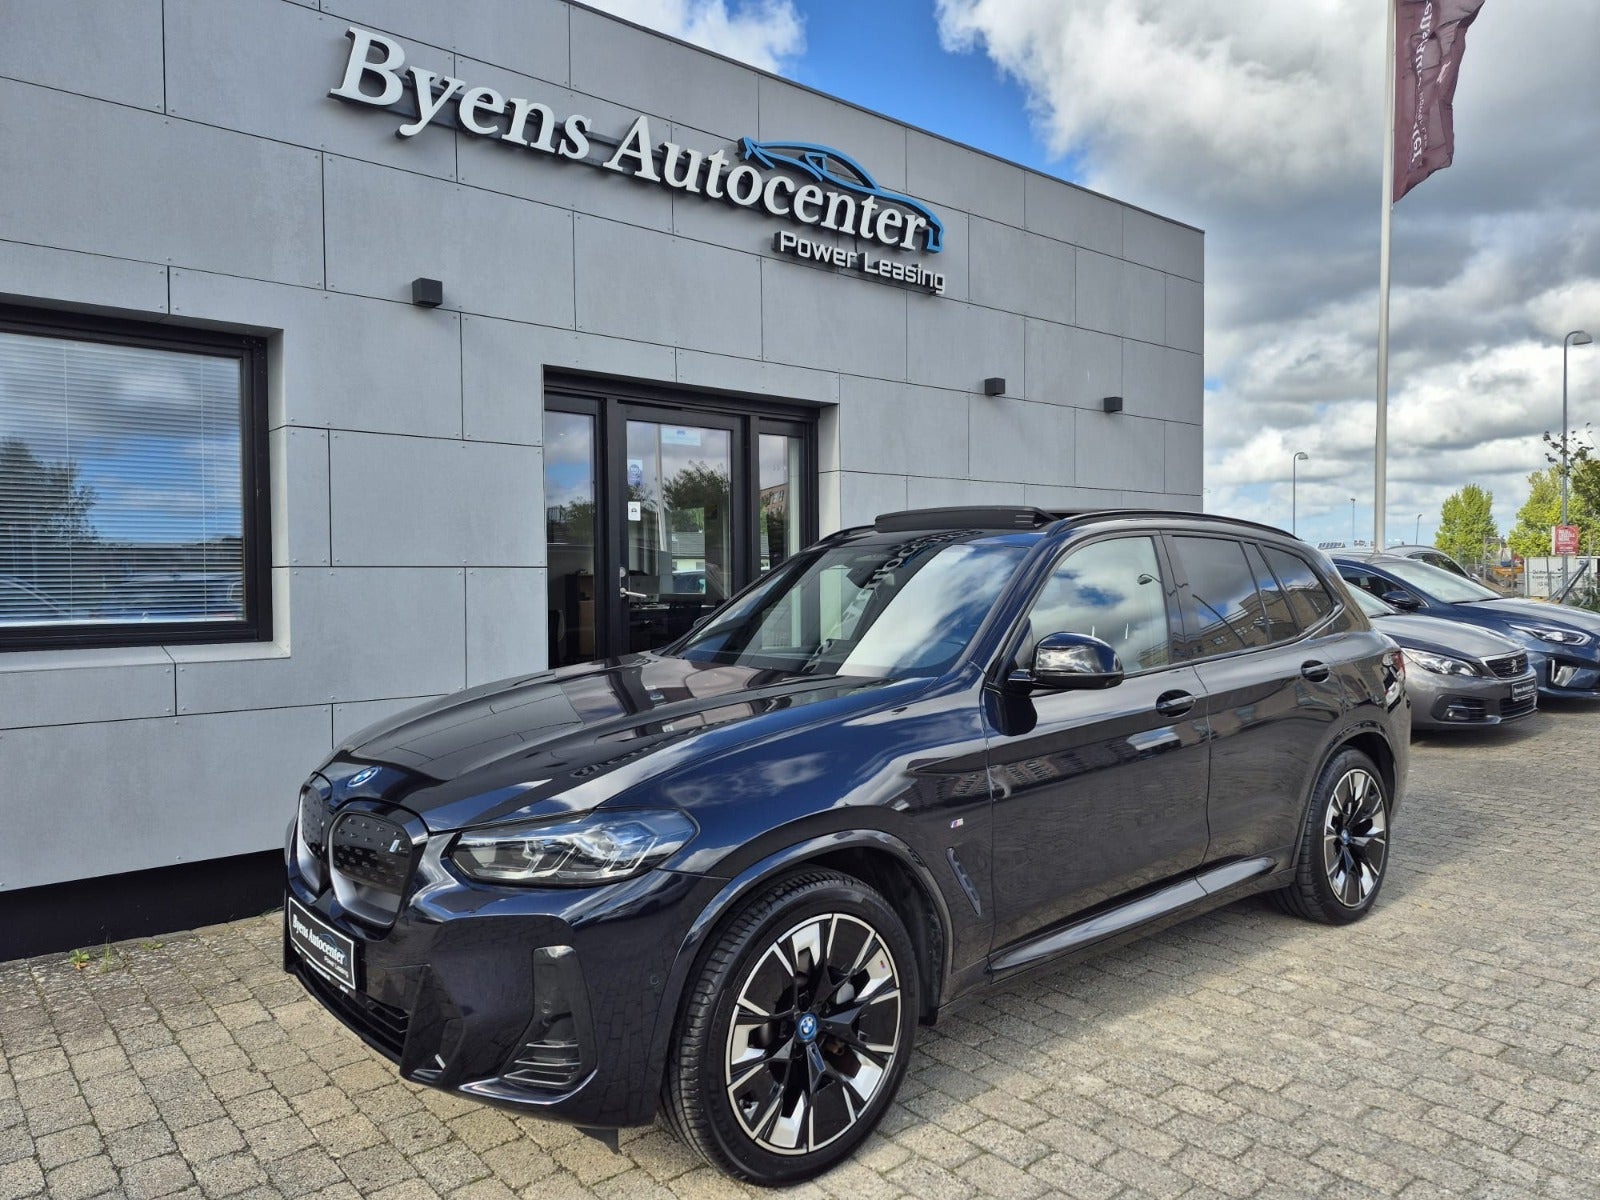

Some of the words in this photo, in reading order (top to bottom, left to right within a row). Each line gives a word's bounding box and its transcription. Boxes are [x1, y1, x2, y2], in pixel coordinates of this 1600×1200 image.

[329, 26, 592, 160] Byens
[602, 114, 926, 250] Autocenter
[778, 230, 858, 268] Power
[863, 251, 946, 294] Leasing
[292, 913, 309, 939] Byens
[308, 928, 346, 965] Autocenter
